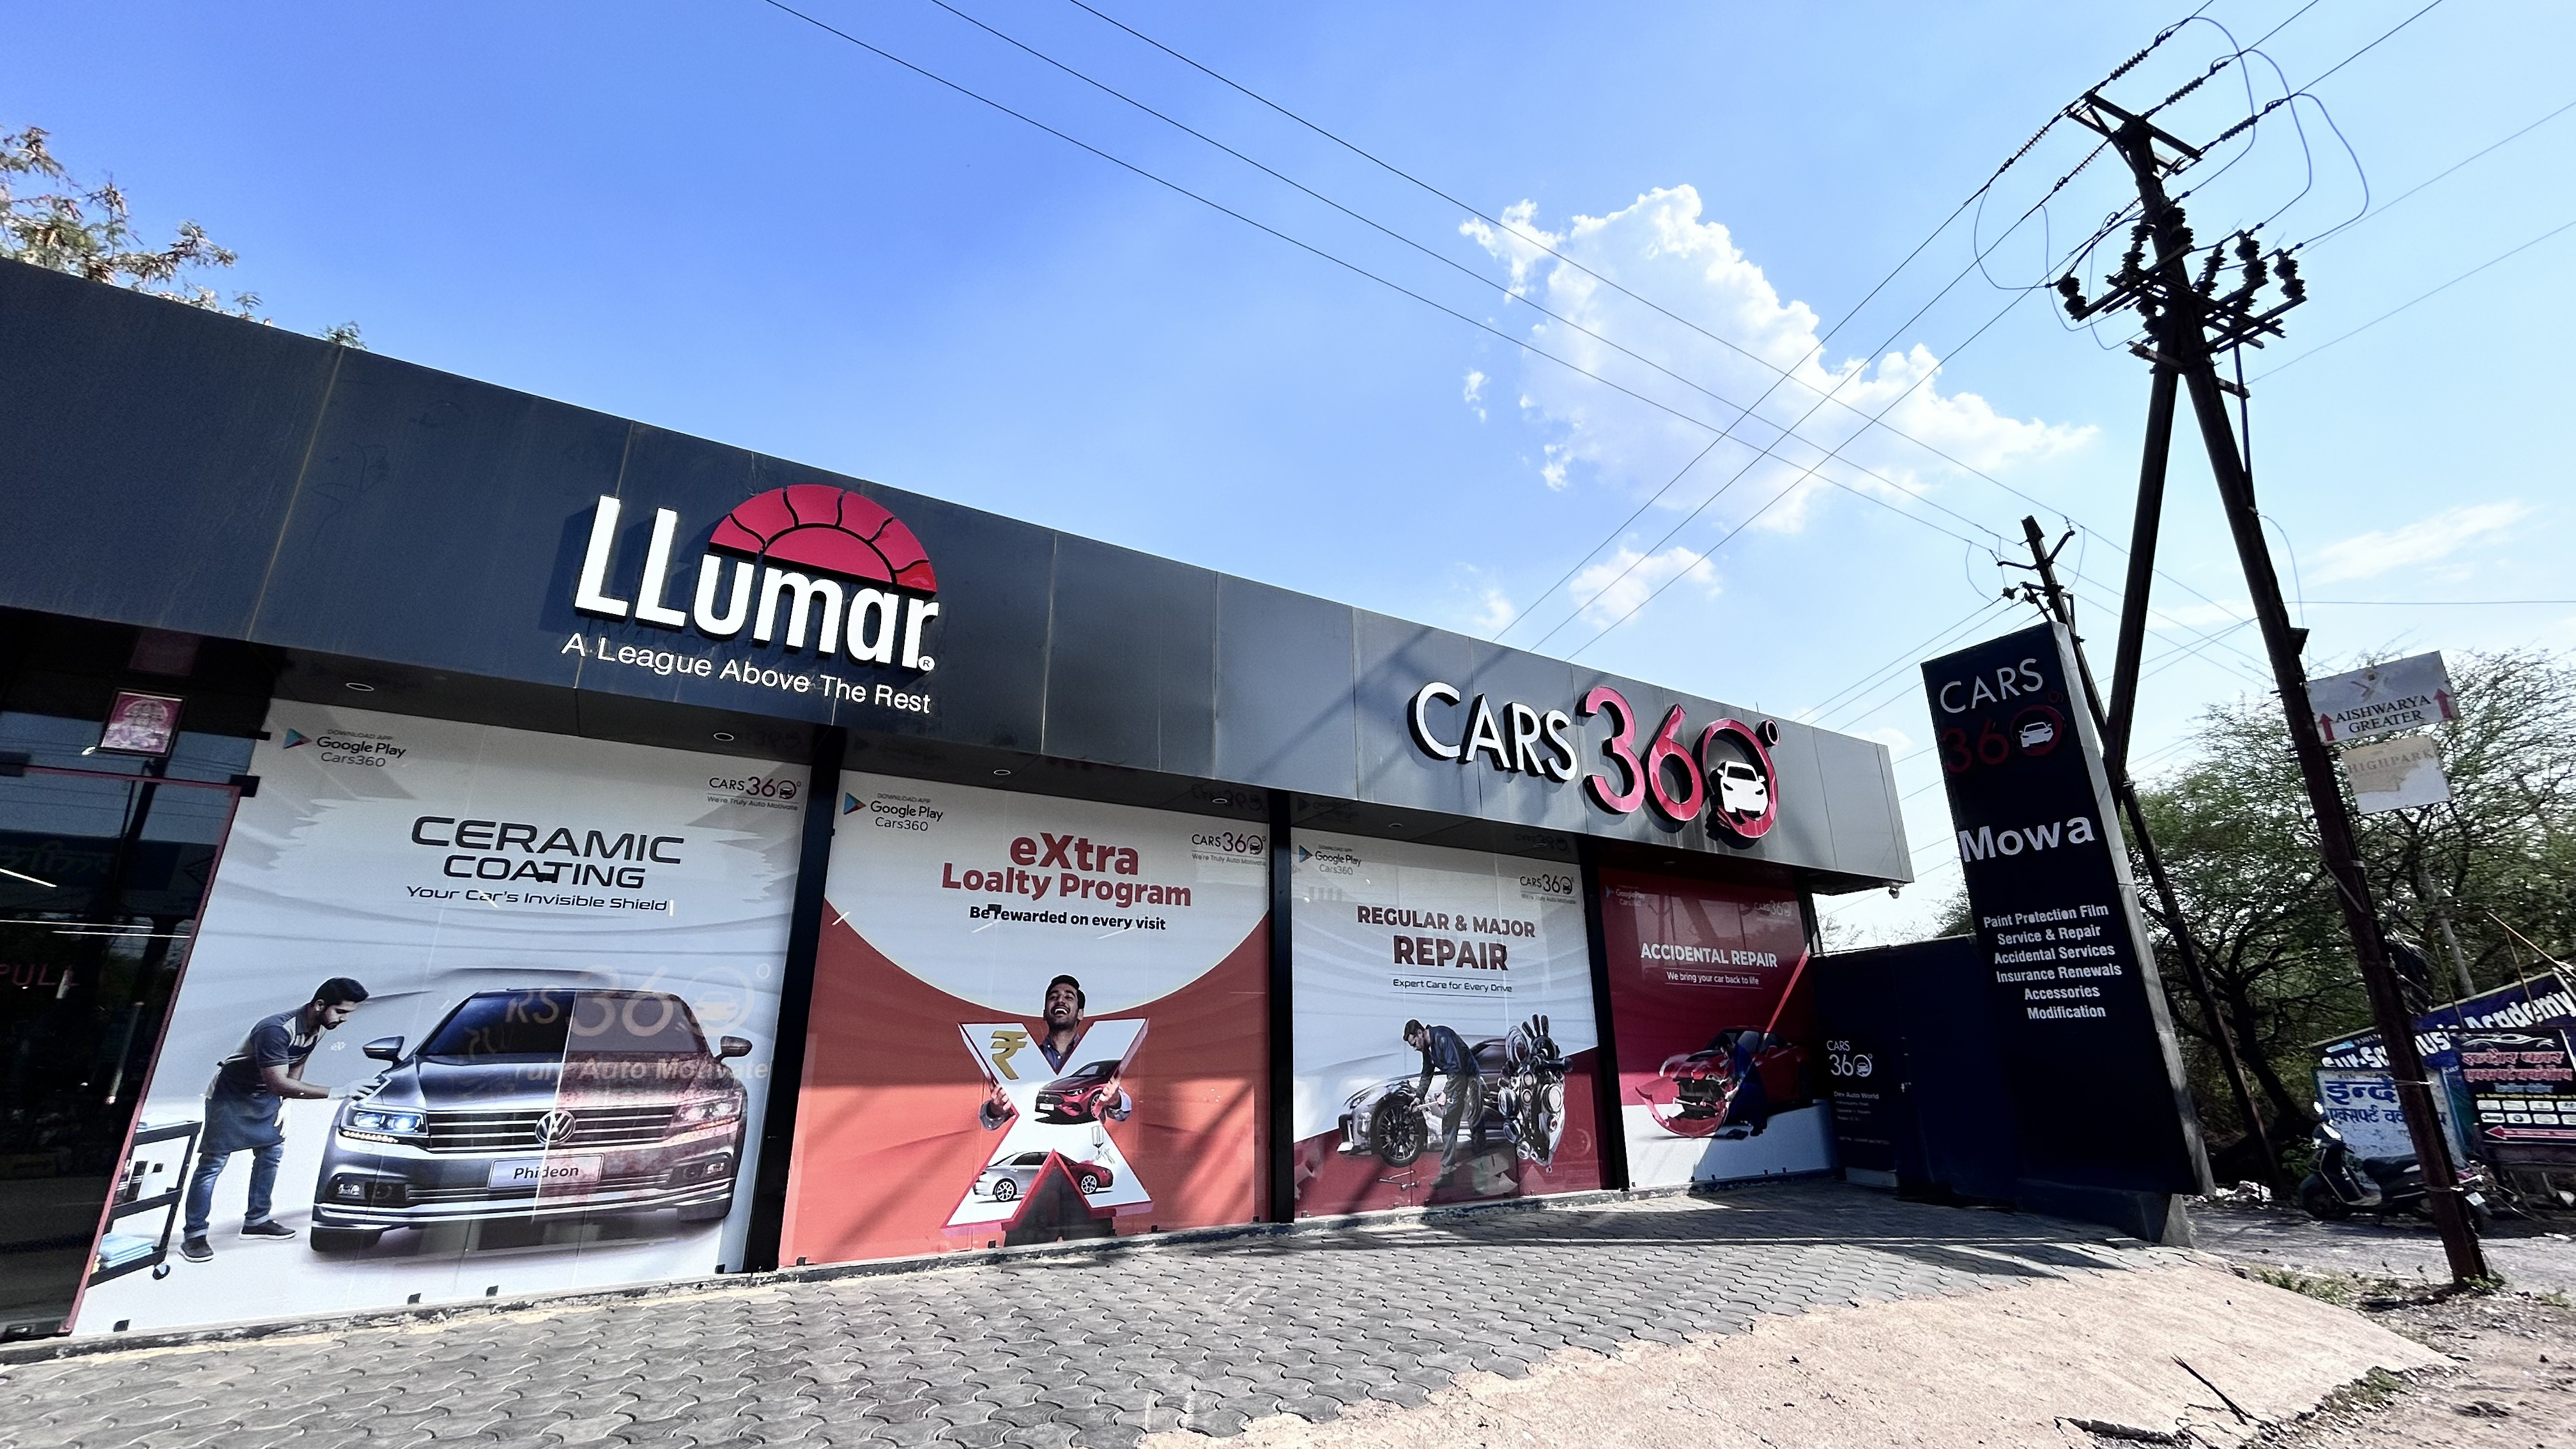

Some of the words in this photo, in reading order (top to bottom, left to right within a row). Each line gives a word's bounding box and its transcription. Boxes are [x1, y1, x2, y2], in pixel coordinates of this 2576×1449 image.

[574, 494, 940, 671] LLumar
[561, 632, 586, 656] A
[597, 636, 712, 676] League
[719, 659, 810, 693] Above
[820, 674, 866, 703] The
[874, 685, 931, 714] Rest
[1940, 658, 2043, 713] CARS
[2335, 694, 2431, 723] AISHWARYA
[1414, 681, 1579, 781] CARS
[2349, 710, 2425, 734] GREATER
[317, 736, 373, 754] Google
[375, 742, 407, 759] Play
[321, 751, 386, 767] Cars360
[709, 777, 744, 791] CARS
[730, 797, 747, 807] Truly
[767, 802, 798, 811] Motivate
[870, 801, 916, 818] Google
[918, 806, 944, 822] Play
[875, 816, 928, 831] Cars360
[411, 816, 684, 865] CERAMIC
[1192, 834, 1221, 847] CARS
[1958, 816, 2096, 863] Mowa
[1009, 832, 1139, 876] eXtra
[1315, 850, 1345, 865] Google
[1345, 854, 1361, 868] Play
[443, 855, 646, 889] COATING
[942, 862, 1052, 901] Loalty
[1059, 873, 1192, 908] Program
[406, 885, 459, 900] Your
[465, 889, 519, 904] Car's
[524, 892, 604, 908] Invisible
[609, 897, 667, 911] Shield
[970, 906, 990, 919] Be
[993, 909, 1067, 924] rewarded
[1071, 914, 1089, 925] on
[1092, 916, 1133, 930] every
[1136, 916, 1166, 930] visit
[1357, 905, 1450, 931] REGULAR
[1455, 916, 1468, 932] &
[1473, 917, 1536, 938] MAJOR
[1983, 915, 2013, 928] Paint
[2015, 908, 2077, 925] Protection
[2079, 904, 2109, 917] Film
[1997, 931, 2043, 945] Service
[2046, 929, 2056, 941] &
[2058, 924, 2101, 940] Repair
[1393, 934, 1508, 971] REPAIR
[1640, 942, 1729, 964] ACCIDENTAL
[1731, 949, 1778, 968] REPAIR
[1995, 948, 2056, 964] Accidental
[2058, 944, 2115, 959] Services
[1666, 971, 1679, 980] We
[1680, 972, 1697, 983] bring
[1698, 975, 1713, 983] your
[1725, 976, 1741, 984] back
[1996, 969, 2055, 983] Insurance
[2057, 963, 2122, 979] Renewals
[1393, 979, 1425, 990] Expert
[1425, 980, 1447, 989] Care
[1448, 981, 1462, 990] for
[1464, 983, 1489, 992] Every
[1491, 984, 1512, 993] Drive
[2024, 985, 2101, 1000] Accessories
[2027, 1004, 2106, 1020] Modification
[1827, 1040, 1850, 1052] CARS
[513, 1166, 579, 1180] Phideon
